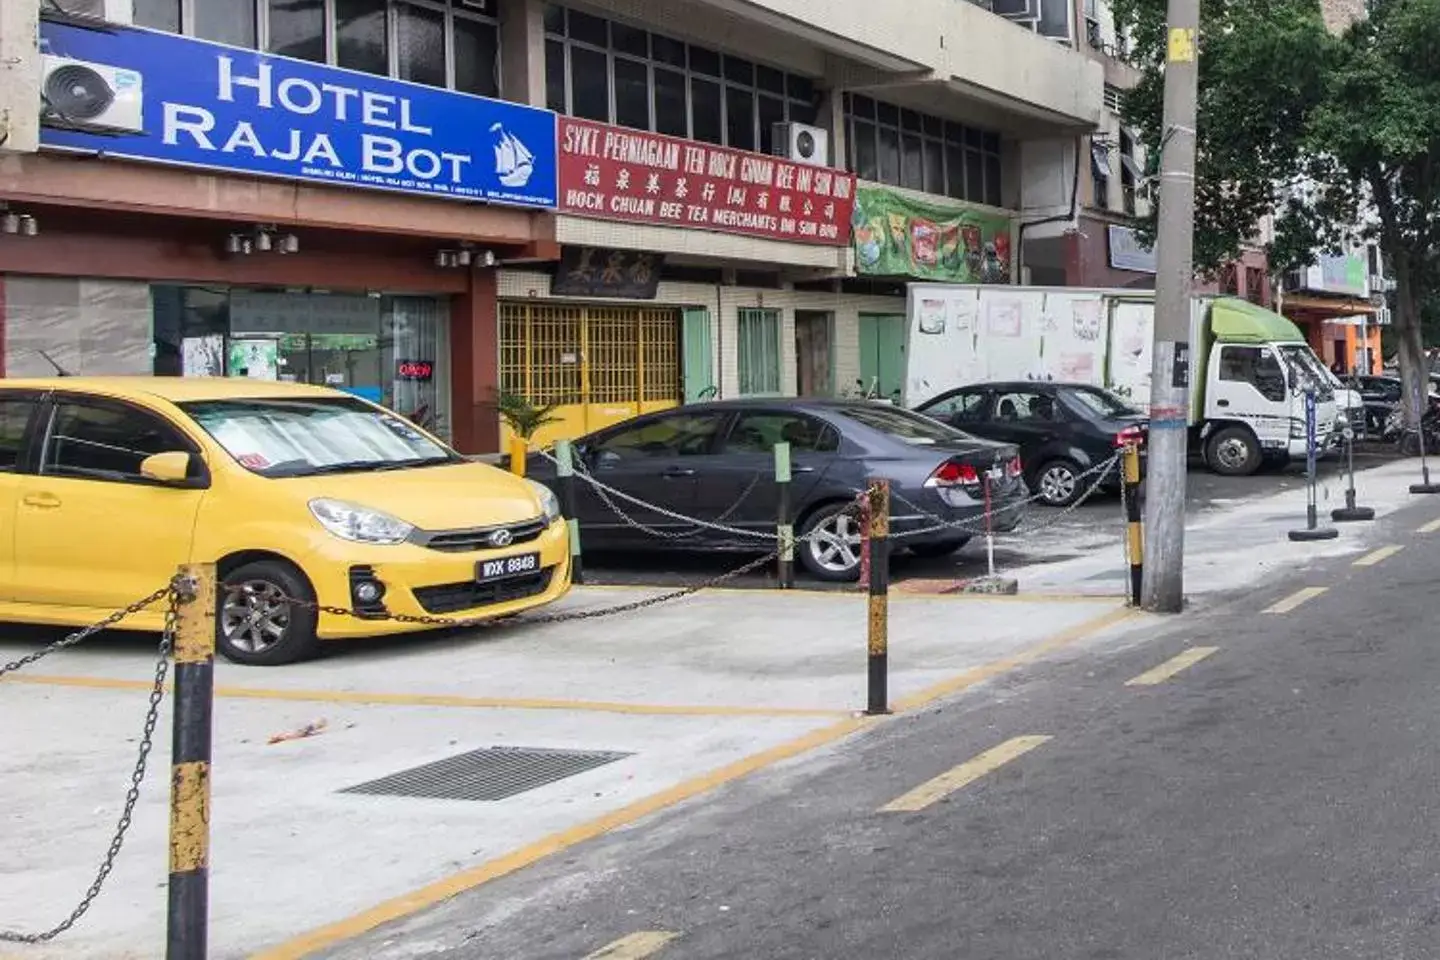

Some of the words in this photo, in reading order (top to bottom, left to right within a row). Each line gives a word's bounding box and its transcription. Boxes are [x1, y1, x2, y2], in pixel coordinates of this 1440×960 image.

[217, 55, 433, 137] HOTEL
[162, 101, 343, 168] RAJA
[362, 133, 471, 184] BOT
[563, 124, 600, 158] SYKT.
[684, 145, 706, 175] TEH
[708, 151, 738, 179] HOCK
[776, 164, 795, 189] BEE
[566, 189, 605, 210] HOCK
[610, 195, 655, 216] CHUAN
[660, 201, 684, 219] BEE
[687, 205, 708, 222] TEA
[713, 209, 777, 231] MERCHANTS
